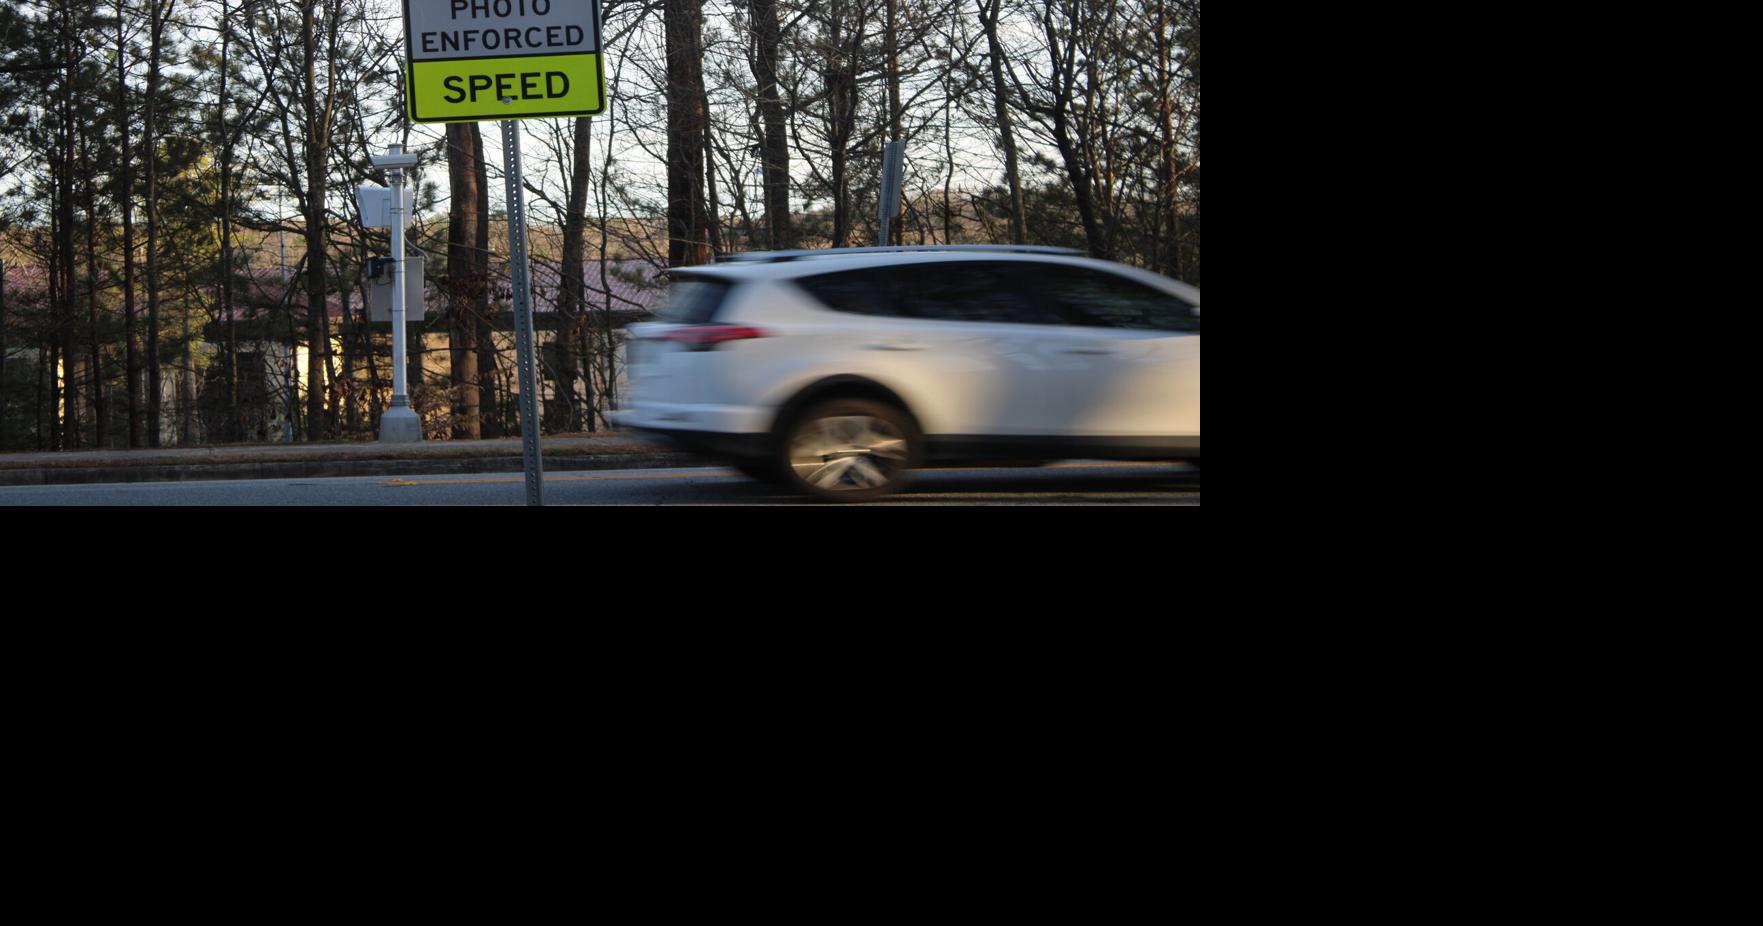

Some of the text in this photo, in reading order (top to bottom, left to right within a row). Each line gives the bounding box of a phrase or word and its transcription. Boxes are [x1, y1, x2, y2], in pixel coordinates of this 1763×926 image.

[451, 0, 550, 19] PHOTO
[421, 25, 584, 52] ENFORCED
[443, 71, 570, 103] SPEED
